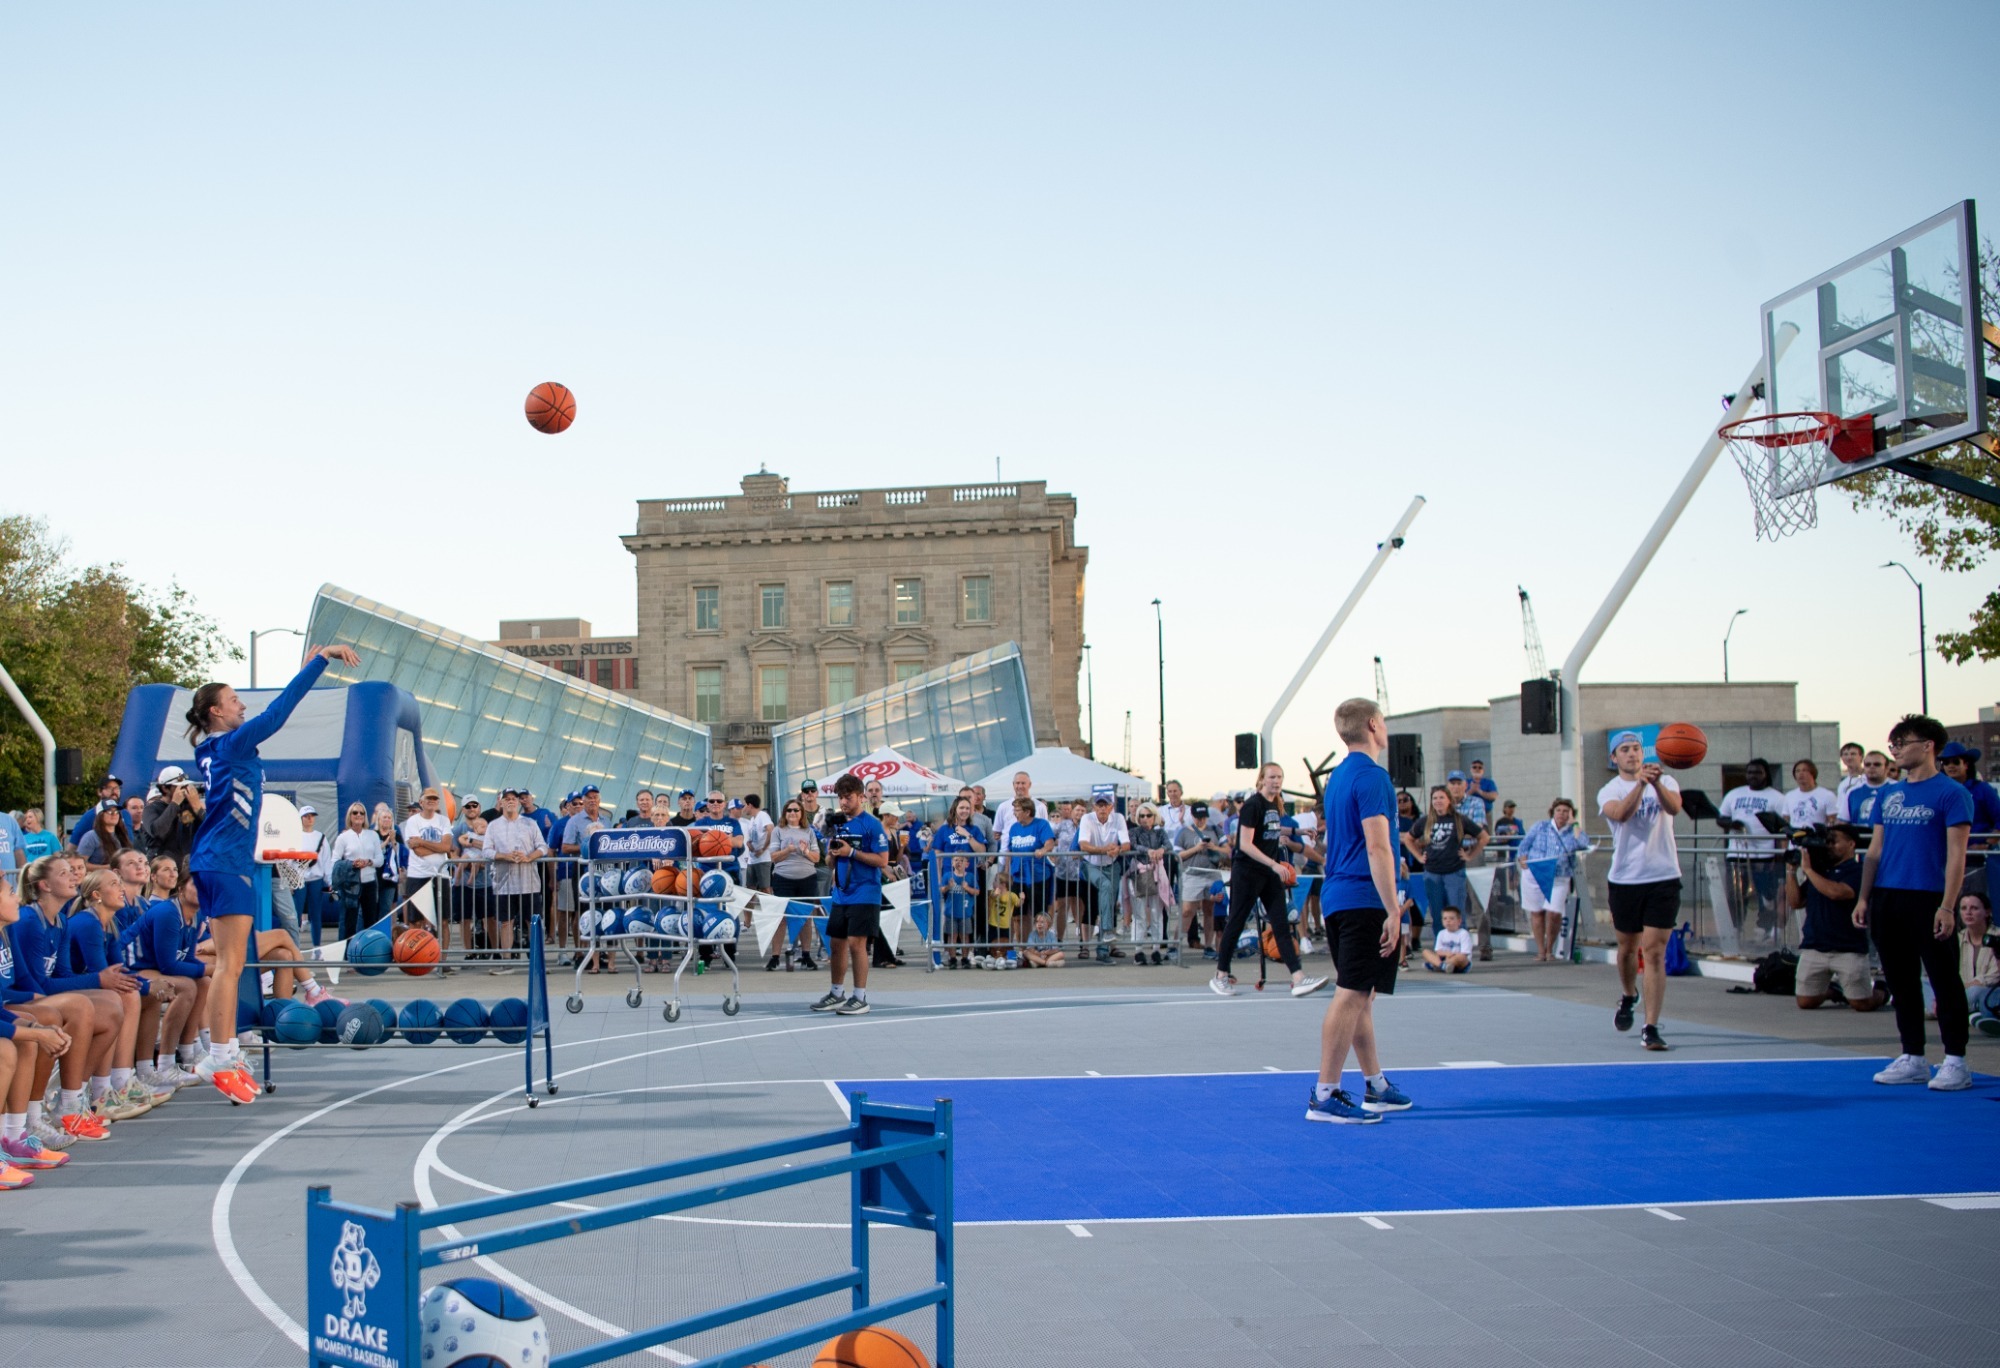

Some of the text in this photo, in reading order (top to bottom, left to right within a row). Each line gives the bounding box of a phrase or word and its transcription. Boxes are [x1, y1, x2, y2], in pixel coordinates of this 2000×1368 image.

[506, 641, 633, 657] EMBASSY SUITES
[201, 756, 213, 792] 3
[1888, 803, 1935, 819] Drake
[325, 1313, 389, 1352] DRAKE
[315, 1335, 353, 1359] WOMEN'S
